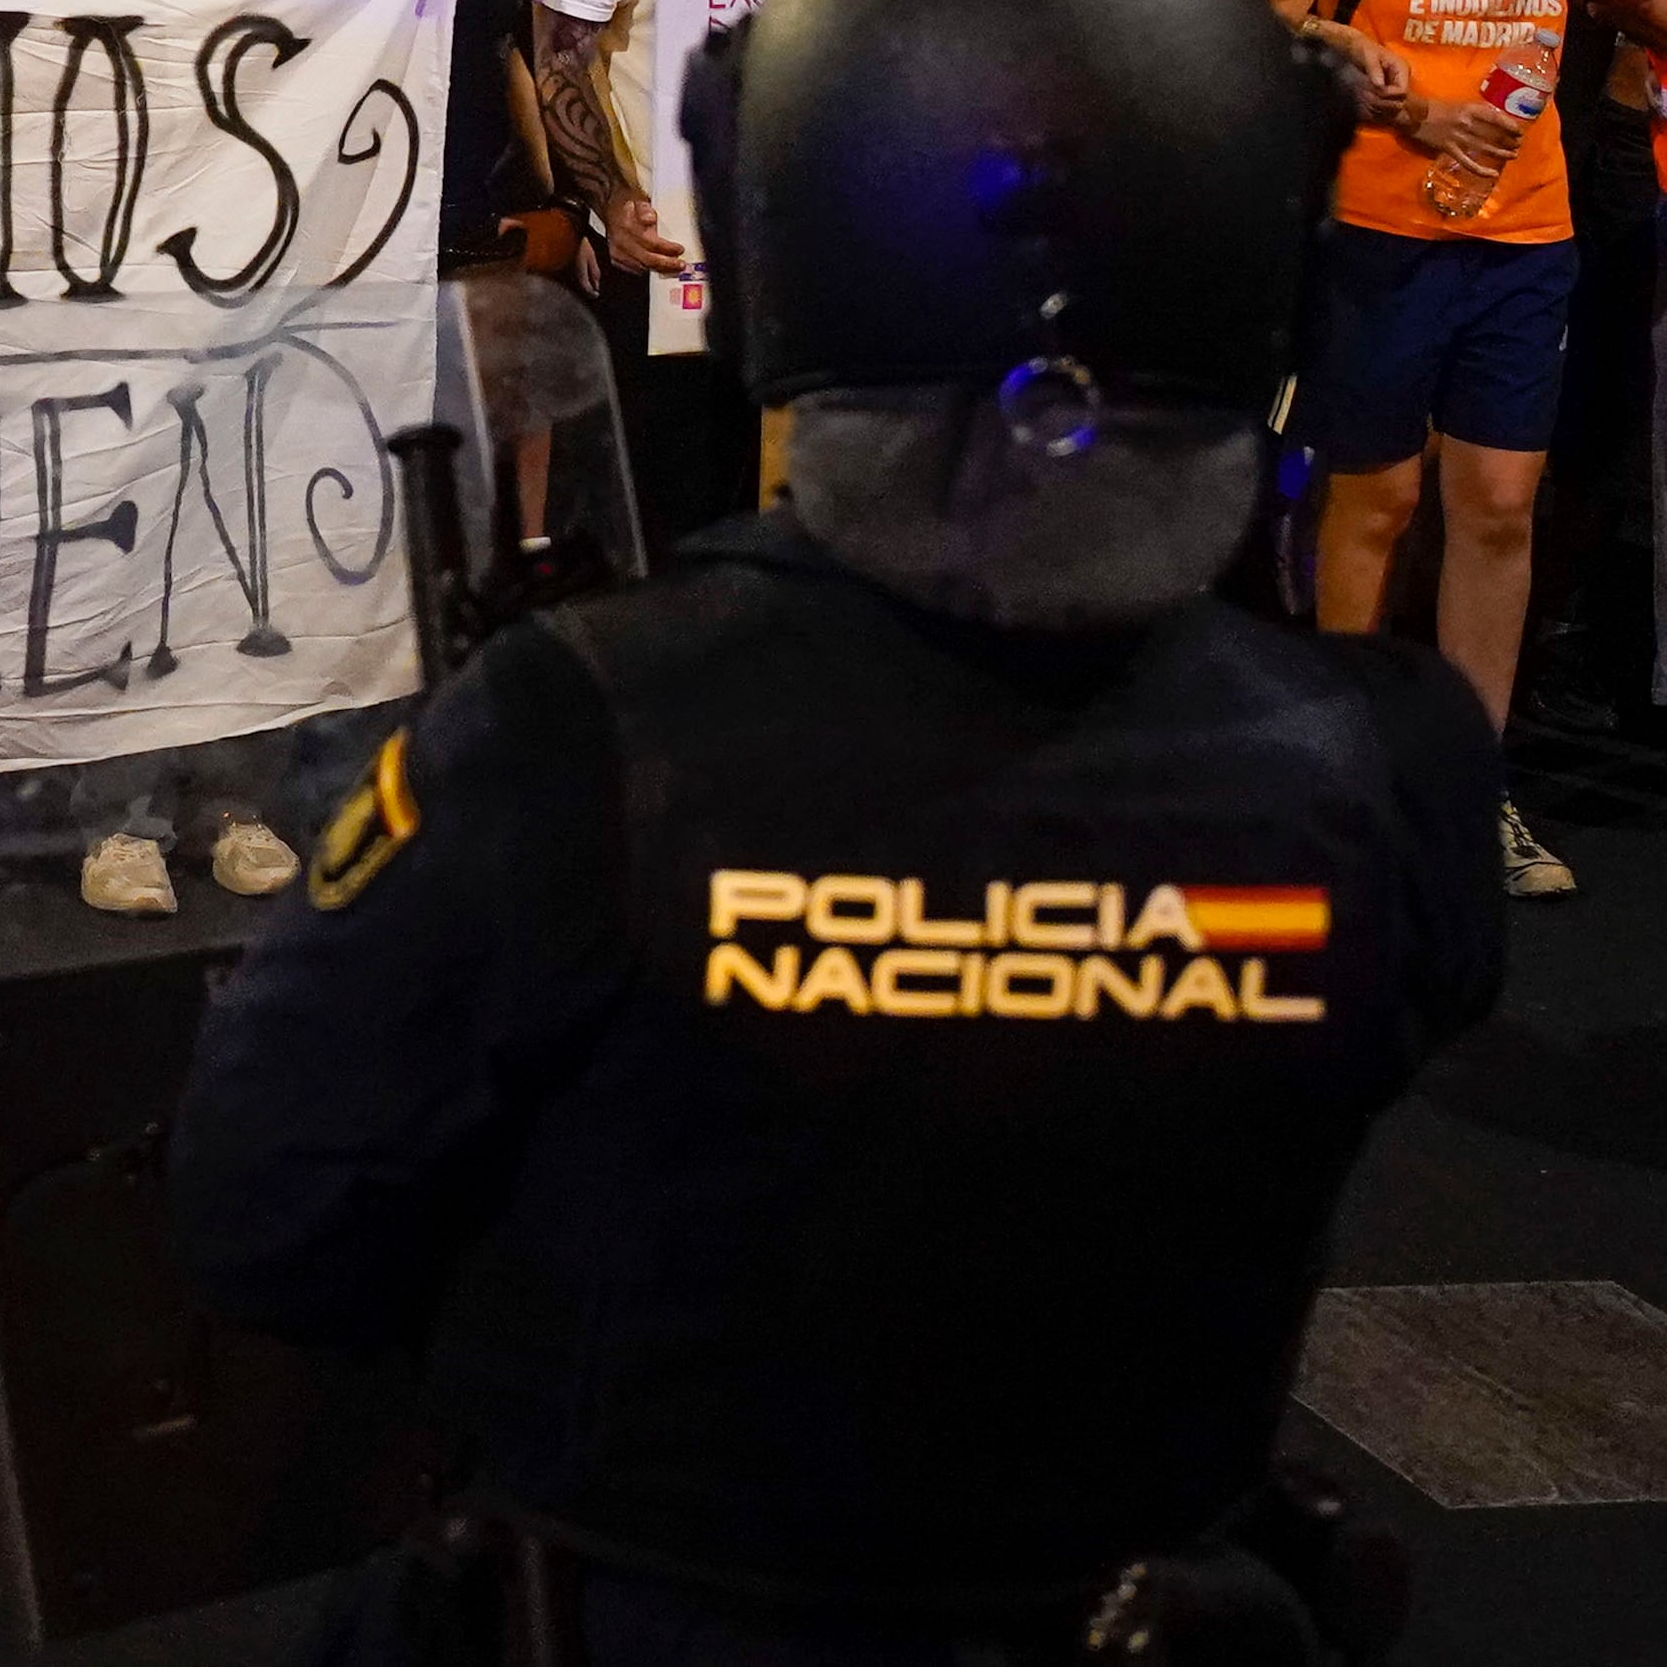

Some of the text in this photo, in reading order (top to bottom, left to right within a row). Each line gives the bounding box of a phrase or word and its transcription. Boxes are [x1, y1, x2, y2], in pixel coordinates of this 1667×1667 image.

[1403, 19, 1536, 49] DE MADRID
[708, 868, 1201, 951] POLICIA
[703, 941, 1327, 1023] NACIONAL
